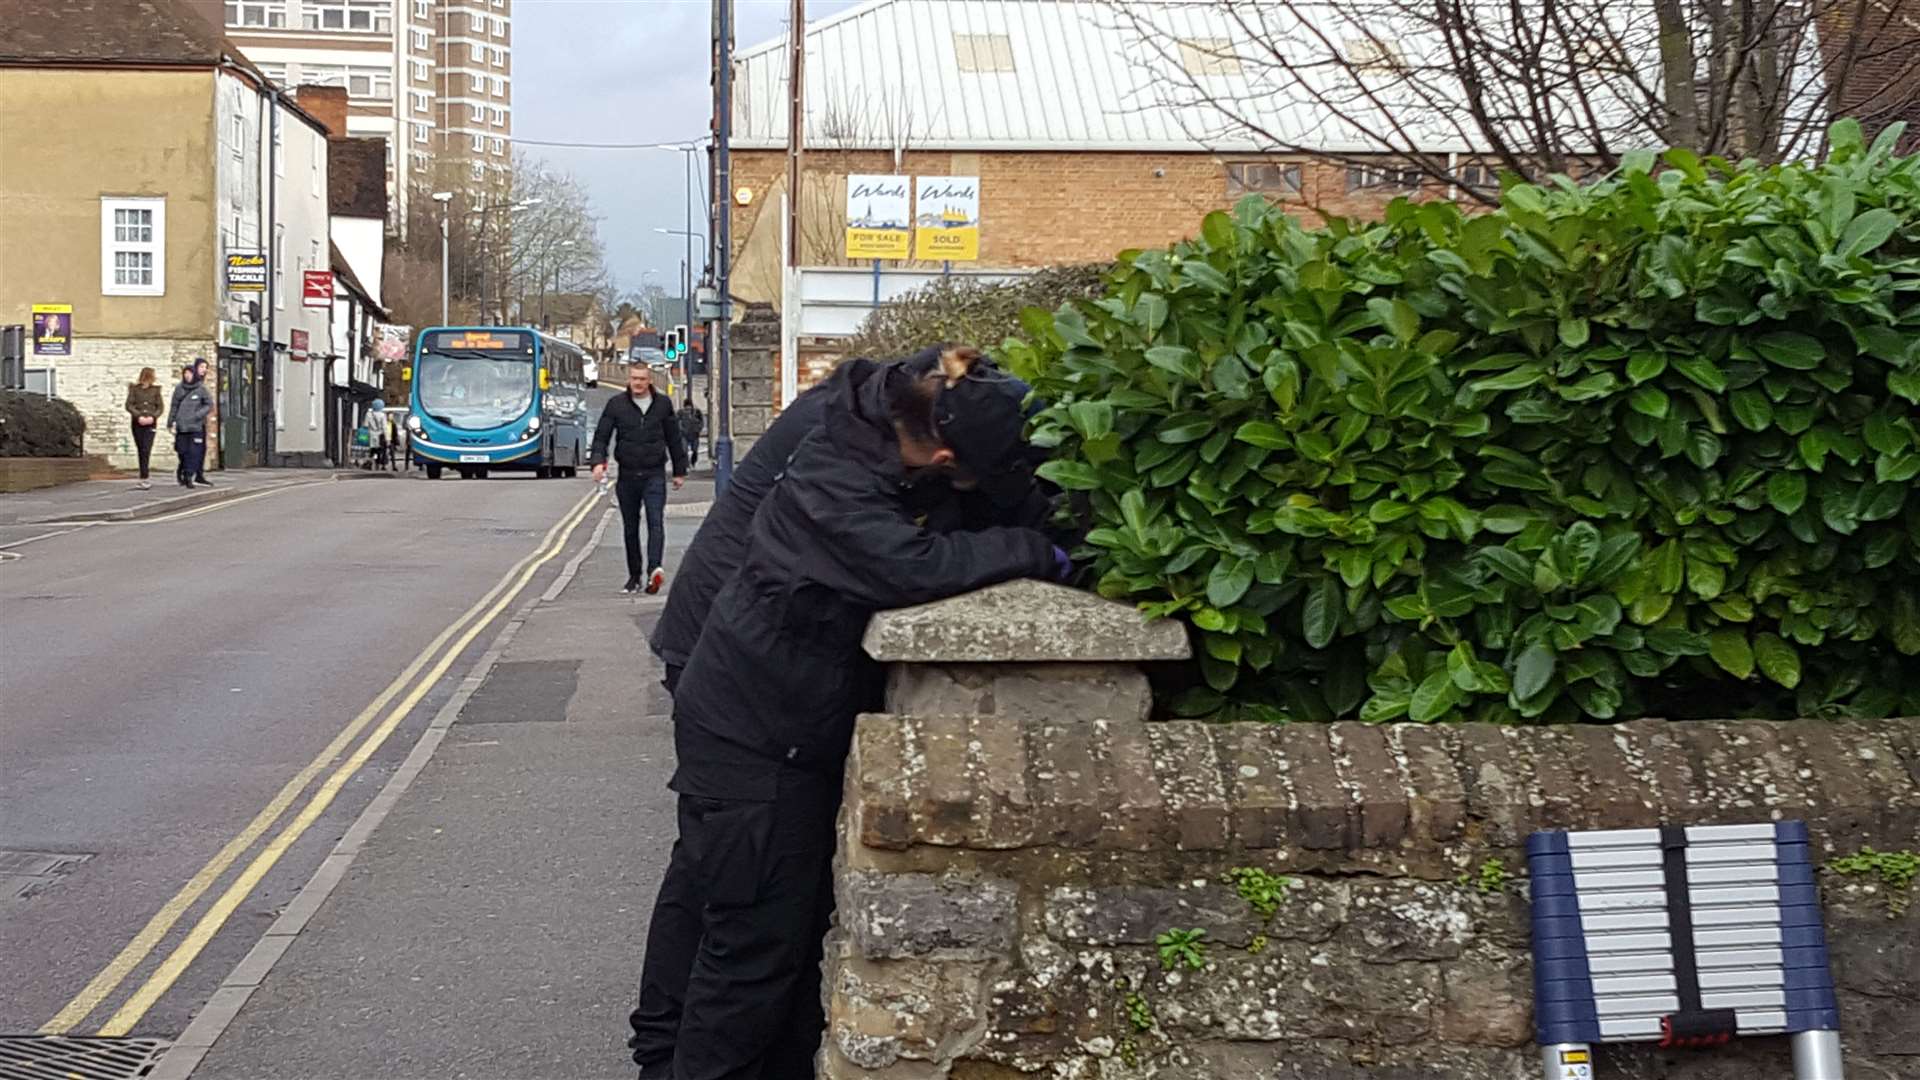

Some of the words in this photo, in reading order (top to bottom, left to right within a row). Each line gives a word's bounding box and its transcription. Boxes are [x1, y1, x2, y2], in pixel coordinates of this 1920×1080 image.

[851, 183, 905, 198] Wards
[920, 184, 974, 200] Wards
[878, 234, 901, 242] SALE
[933, 235, 961, 244] SOLD
